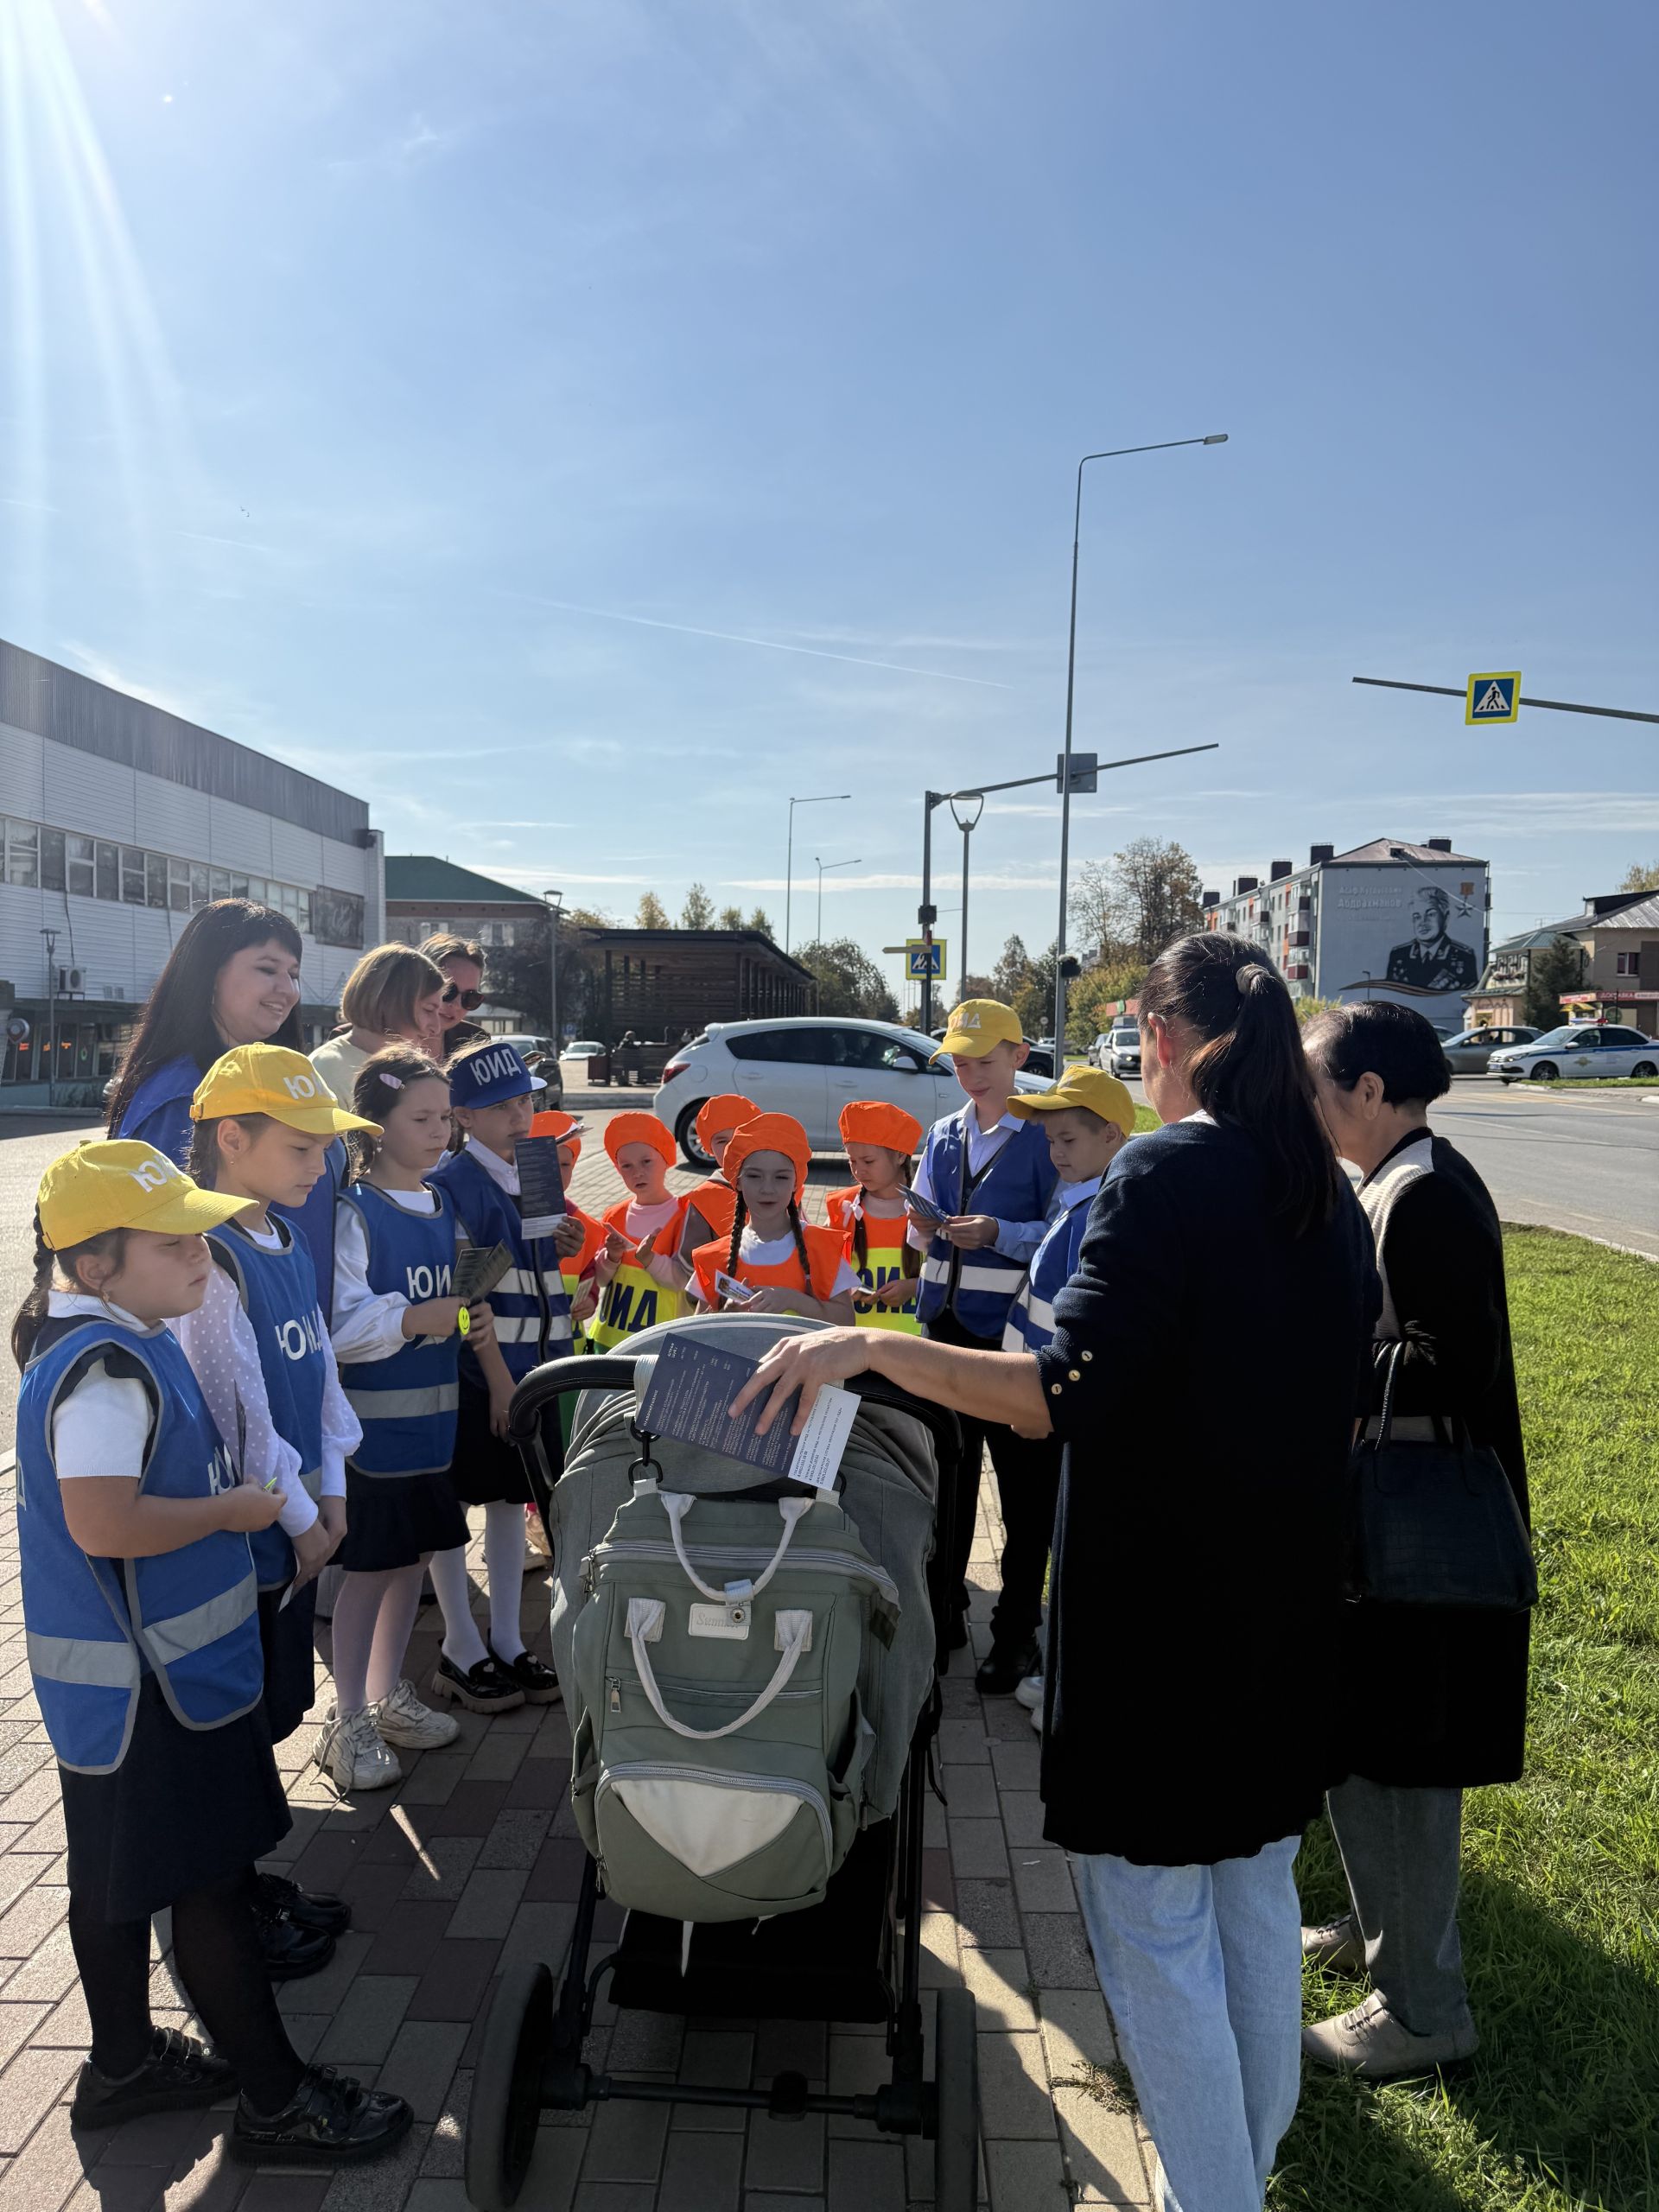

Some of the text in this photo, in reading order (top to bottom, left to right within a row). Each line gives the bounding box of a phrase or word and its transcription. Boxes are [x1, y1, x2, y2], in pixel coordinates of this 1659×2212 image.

[469, 1048, 522, 1086] ЮИД
[128, 1154, 177, 1192] ЮИ
[406, 1264, 452, 1299] ЮИ
[207, 1443, 235, 1496] ЮИ
